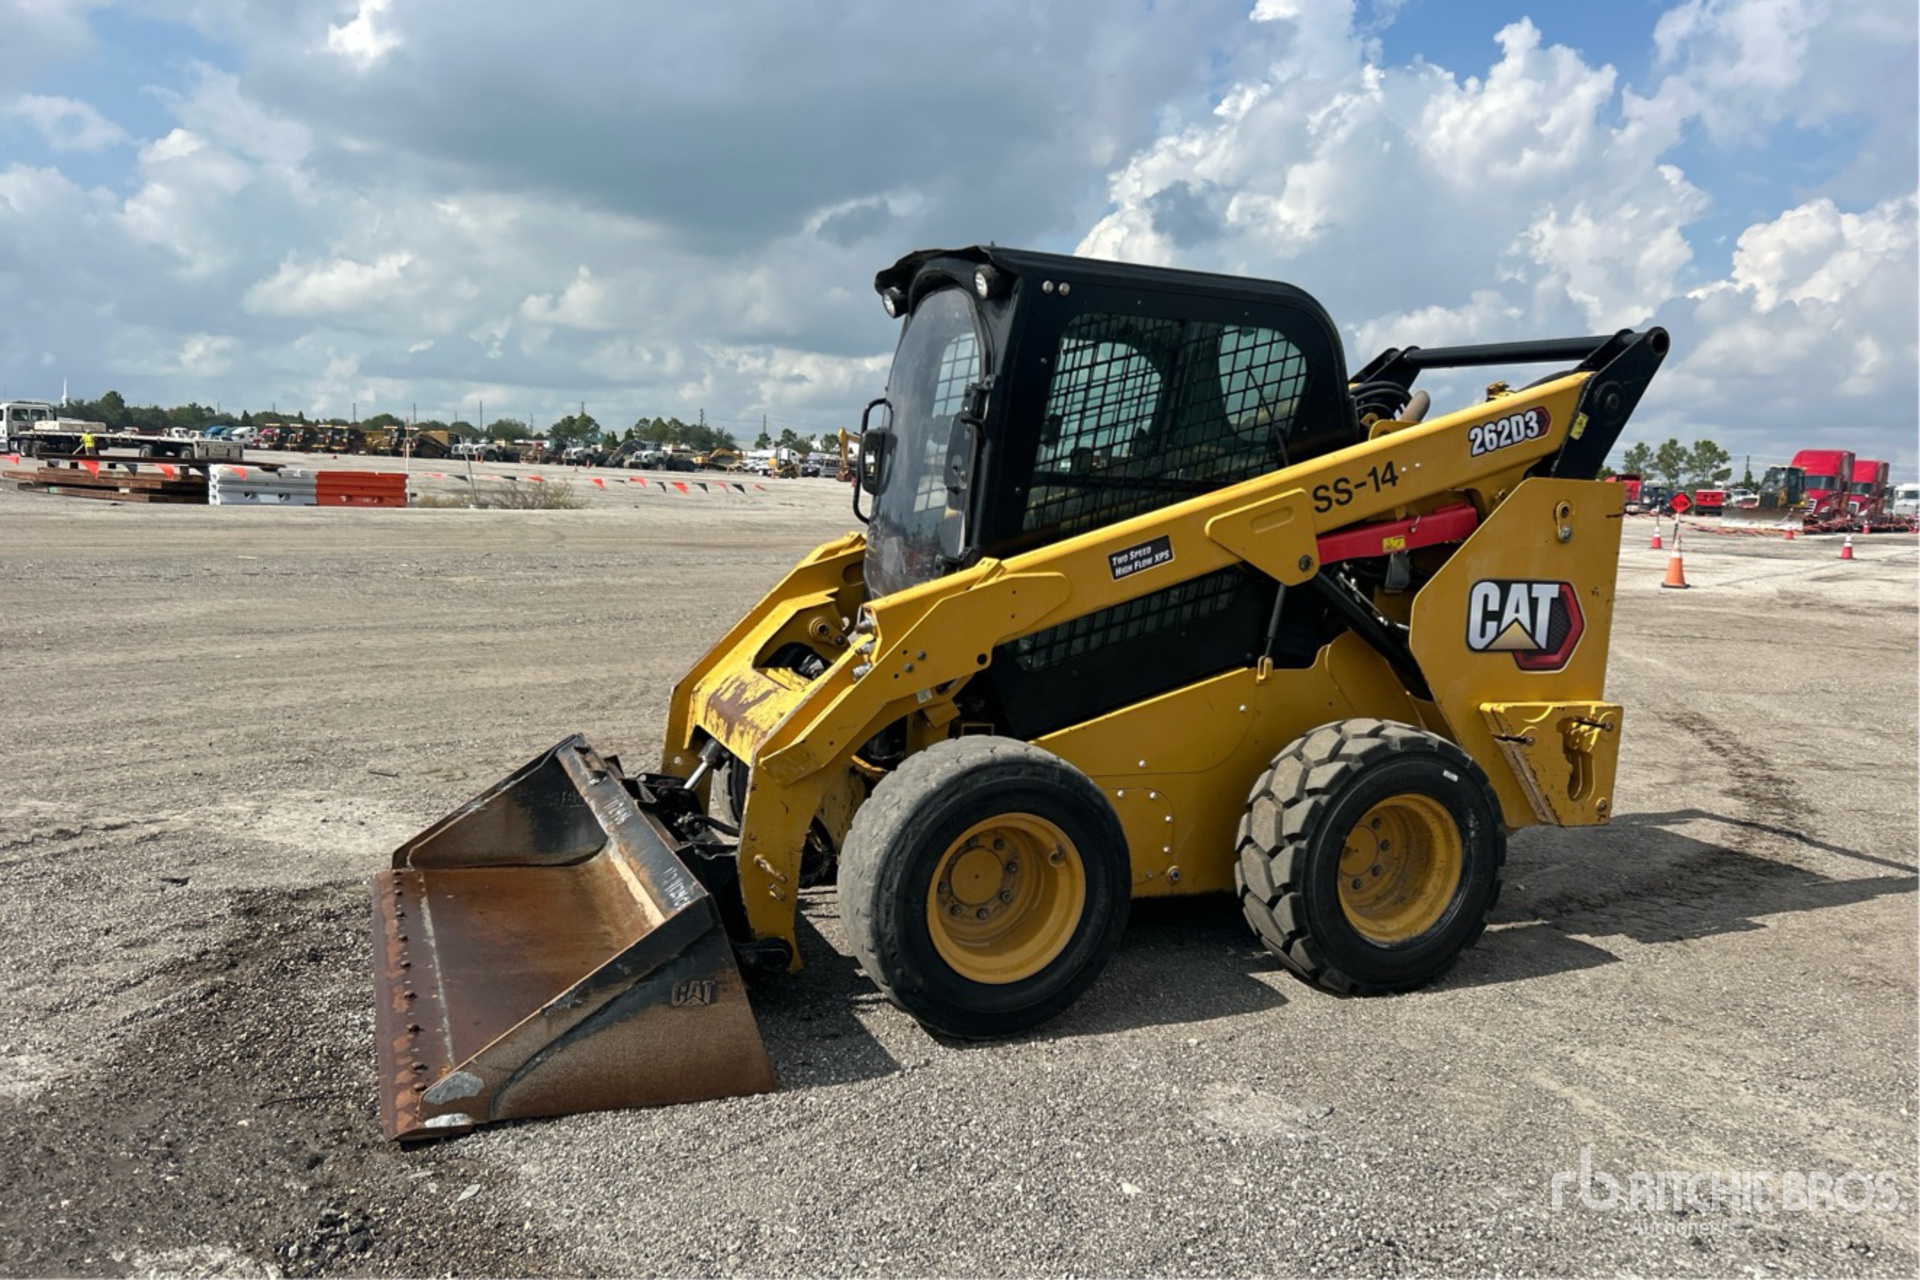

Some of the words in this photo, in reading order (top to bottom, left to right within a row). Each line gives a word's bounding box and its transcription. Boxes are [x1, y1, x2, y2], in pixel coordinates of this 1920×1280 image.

[1469, 410, 1539, 456] 262D3
[1312, 461, 1399, 513] SS-14
[1112, 554, 1129, 566] TWO
[1129, 546, 1152, 560] SPEED
[1115, 564, 1133, 577] HIGH
[1134, 557, 1153, 570] FLOW
[1154, 549, 1170, 563] XPS
[1468, 581, 1560, 650] CAT
[671, 980, 716, 1007] CAT
